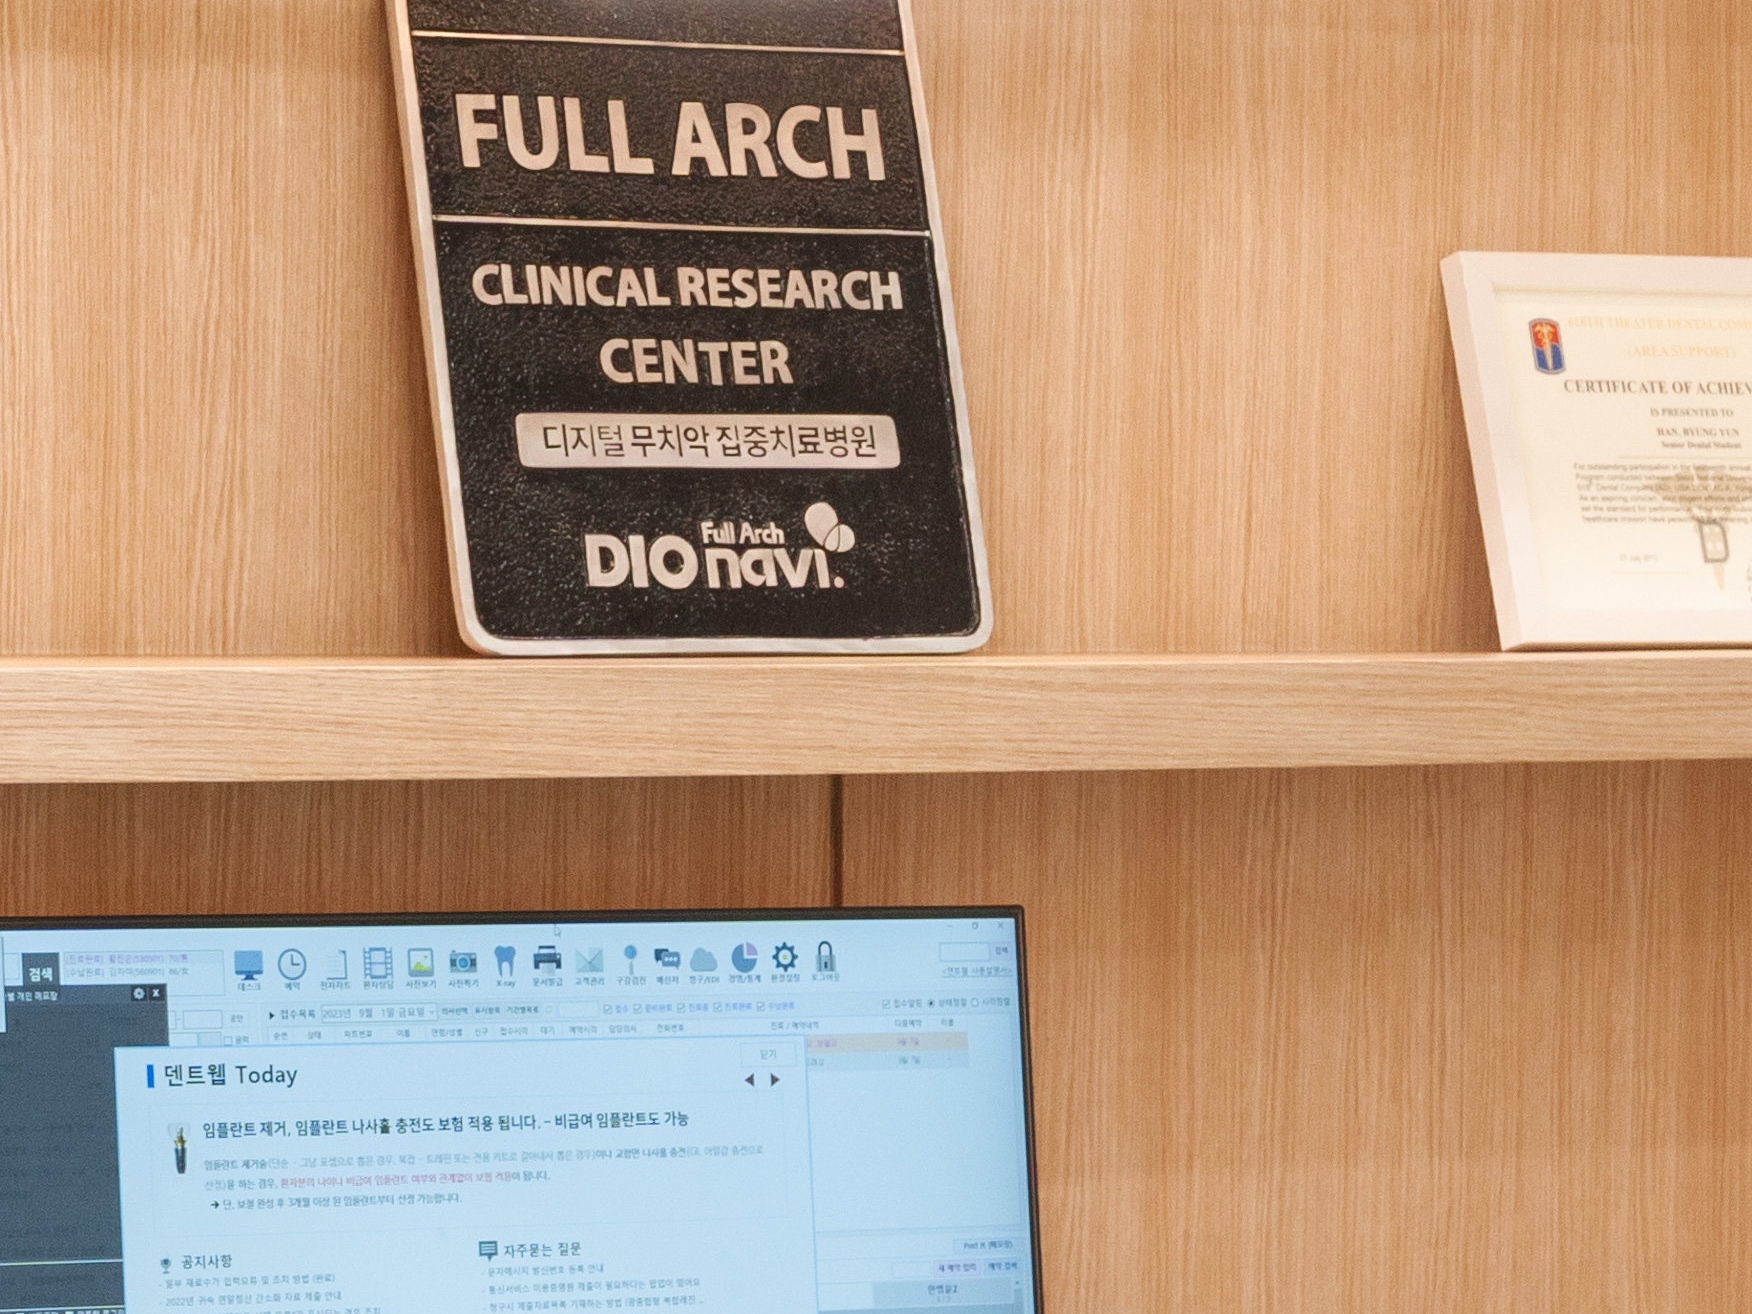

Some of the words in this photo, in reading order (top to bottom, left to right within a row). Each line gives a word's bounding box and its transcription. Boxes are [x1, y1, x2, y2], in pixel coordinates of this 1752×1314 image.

[455, 92, 655, 175] FULL
[671, 101, 886, 181] ARCH
[471, 263, 671, 308] CLINICAL
[678, 265, 903, 311] RESEARCH
[1607, 318, 1664, 330] THEATER
[1667, 319, 1715, 330] DENTAL
[1627, 346, 1668, 358] (AREA
[1672, 347, 1736, 359] SUPPORT)
[599, 337, 794, 386] CENTER
[1564, 379, 1668, 394] CERTIFICATE
[1672, 381, 1691, 395] OF
[1651, 408, 1659, 416] IS
[1662, 408, 1718, 417] PRESENTED
[1721, 409, 1734, 418] TO
[542, 423, 625, 457] 디지털
[631, 425, 710, 458] 무치악
[716, 423, 878, 459] 집중치료병원
[700, 521, 736, 544] Full
[740, 521, 784, 544] Arch
[584, 533, 698, 589] DIO
[30, 967, 52, 981] 검색
[238, 981, 261, 991] 데스크
[406, 978, 436, 989] 사진보기
[496, 979, 516, 987] X-ray
[575, 976, 605, 986] 고객관리
[811, 973, 840, 982] 로그아웃
[280, 1009, 315, 1019] 접수목록
[323, 1008, 351, 1019] 2023년
[359, 1008, 373, 1018] 9월
[381, 1007, 395, 1018] 1일
[398, 1007, 424, 1017] 금요일
[760, 1049, 777, 1059] 닫기
[165, 1064, 226, 1086] 덴트웹
[235, 1065, 297, 1087] Today
[203, 1123, 256, 1139] 임플란트
[260, 1121, 290, 1137] 제거,
[296, 1120, 348, 1136] 임플란트
[352, 1119, 390, 1135] 나사홀
[396, 1118, 434, 1134] 충전도
[438, 1117, 463, 1132] 보험
[468, 1116, 493, 1131] 적용
[498, 1115, 540, 1131] 됩니다.
[554, 1113, 592, 1129] 비급여
[596, 1113, 660, 1128] 임플란트도
[664, 1111, 688, 1127] 가능
[313, 1197, 330, 1207] 이상
[504, 1243, 552, 1258] 자주묻는
[557, 1242, 581, 1257] 질문
[182, 1255, 232, 1269] 공지사항
